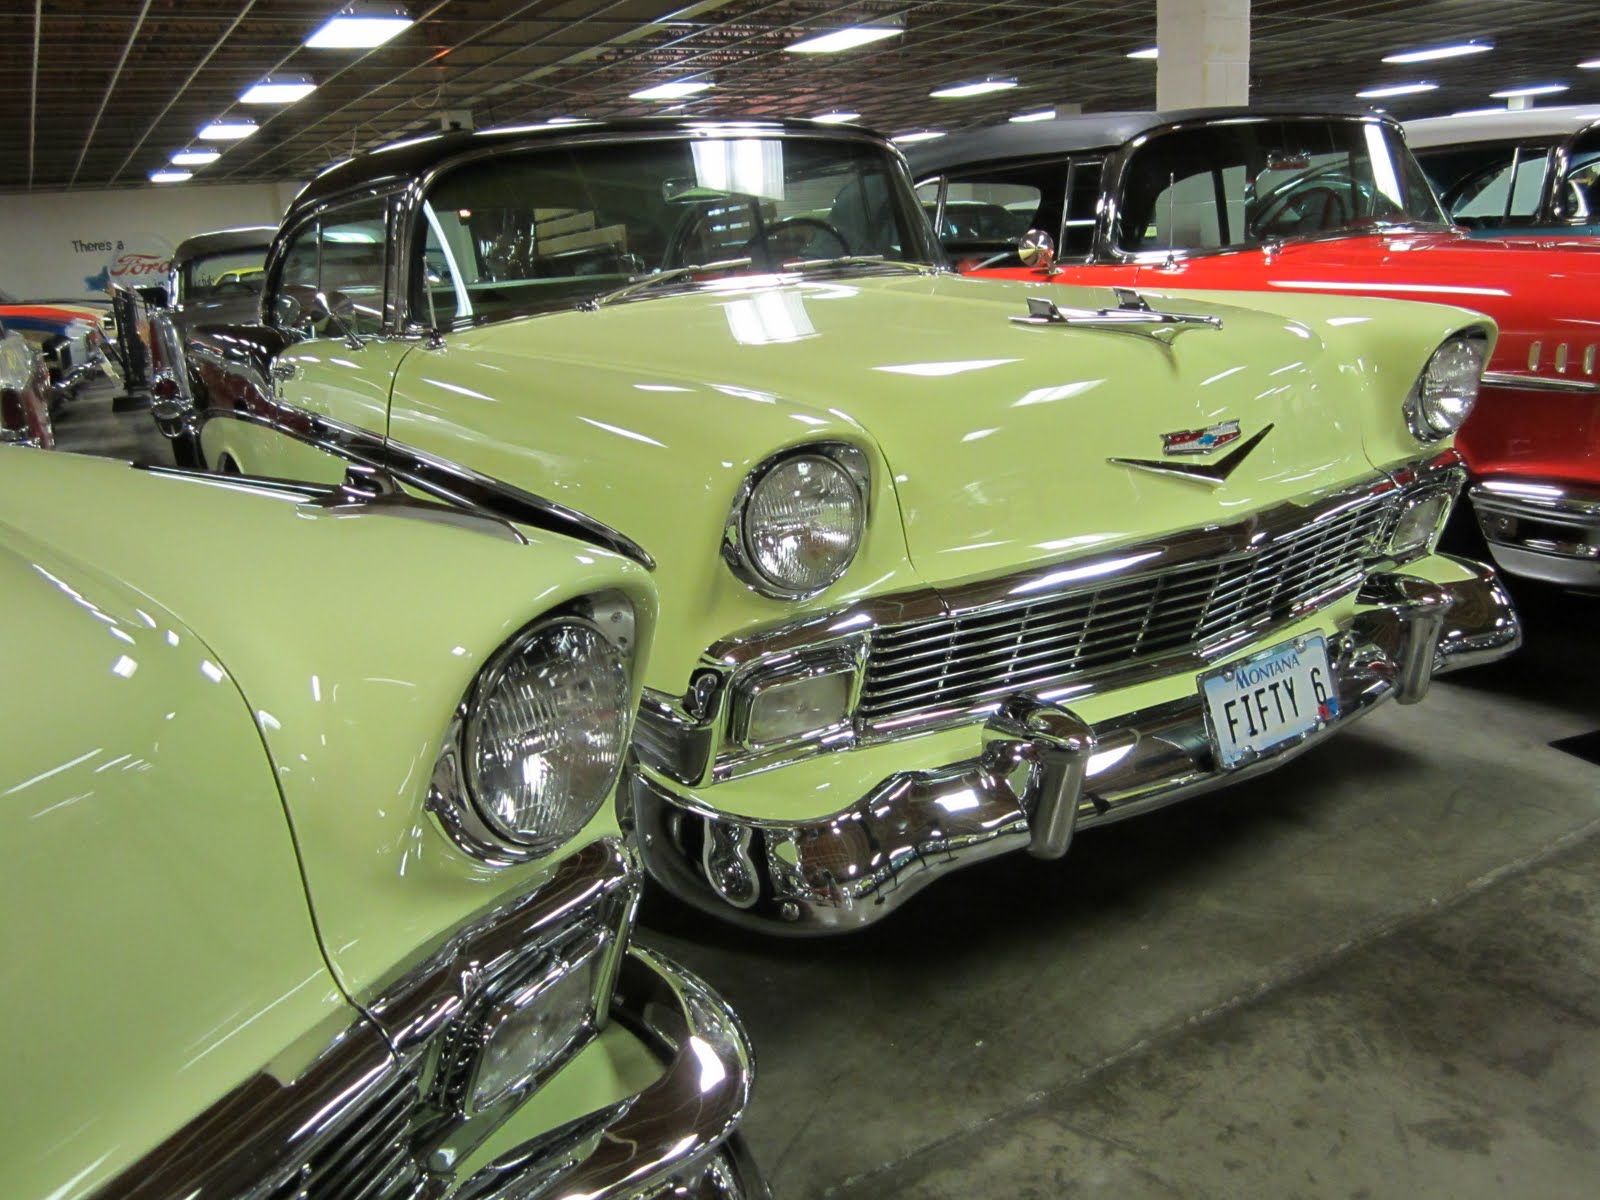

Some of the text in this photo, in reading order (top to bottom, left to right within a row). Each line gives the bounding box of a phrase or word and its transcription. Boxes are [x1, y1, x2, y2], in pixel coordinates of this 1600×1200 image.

[117, 240, 124, 250] a
[1236, 654, 1300, 690] MONTANA
[1224, 667, 1327, 744] FIFTY 6
